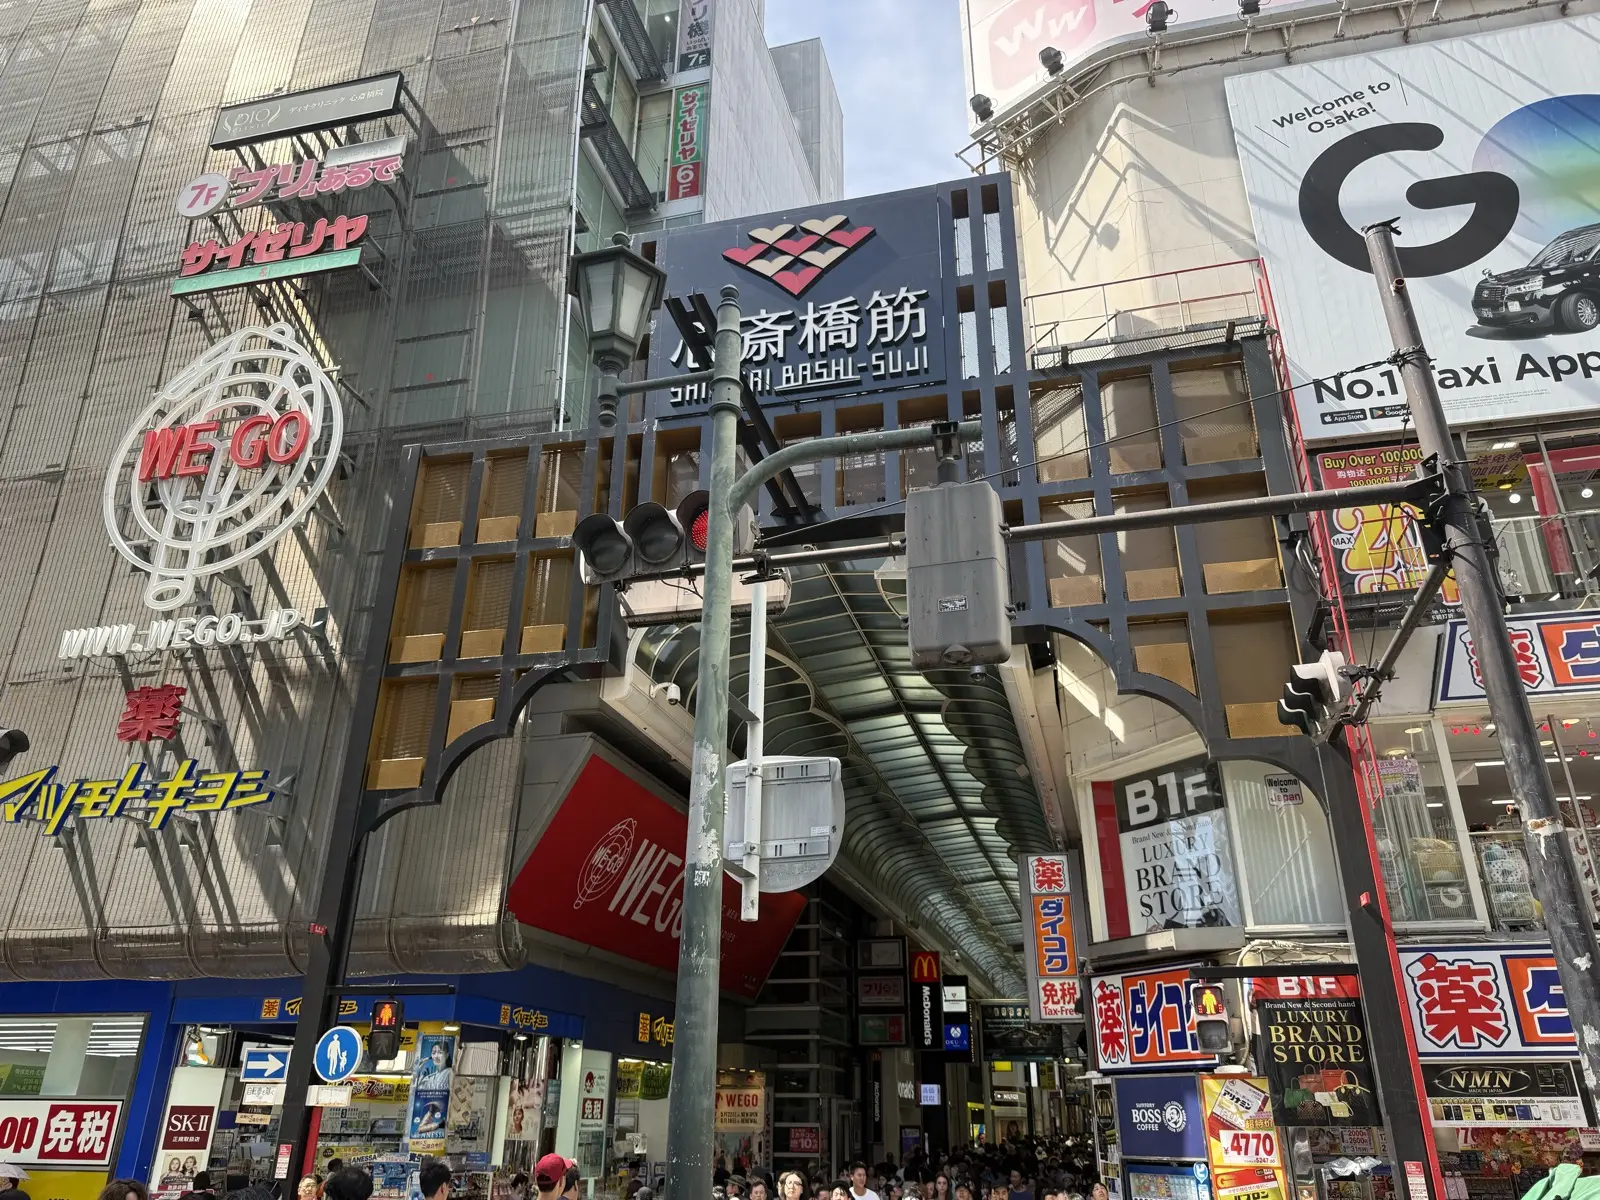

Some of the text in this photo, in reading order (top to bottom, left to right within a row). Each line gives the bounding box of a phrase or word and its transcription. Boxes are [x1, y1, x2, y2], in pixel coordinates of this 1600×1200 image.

[688, 53, 707, 66] 7F
[1272, 80, 1391, 129] Welcome to
[677, 90, 699, 162] サイゼリヤ
[1306, 101, 1377, 135] Osaka!
[676, 165, 694, 199] 6F
[187, 183, 219, 208] 7F
[179, 214, 369, 277] サイゼリヤ
[1313, 368, 1399, 404] No.1
[1515, 349, 1600, 383] App
[1323, 457, 1346, 470] Buy
[1349, 454, 1376, 467] Over
[1331, 536, 1353, 547] MAX
[58, 608, 301, 661] WWW.WEGO.JP
[116, 684, 188, 743] 薬
[1266, 776, 1298, 788] Welcome
[0, 759, 276, 836] マツモトキヨシ
[1124, 771, 1209, 826] B1F
[1269, 792, 1301, 803] Japan
[1131, 833, 1151, 845] Brand
[1151, 830, 1164, 840] New
[1141, 832, 1209, 863] LUXURY
[1034, 856, 1066, 892] 薬
[1135, 853, 1222, 892] BRAND
[1139, 880, 1224, 918] STORE
[1039, 897, 1070, 974] ダイコク
[1041, 981, 1078, 1006] 免税
[1276, 976, 1338, 996] B1F
[263, 999, 279, 1017] 薬
[1265, 1001, 1286, 1009] Brand
[1338, 1000, 1356, 1008] hand
[1410, 956, 1508, 1046] 薬
[921, 985, 933, 1046] McDonald's
[1095, 980, 1128, 1061] 薬
[1276, 1010, 1349, 1024] LUXURY
[1268, 1024, 1362, 1044] BRAND
[1273, 1045, 1365, 1063] STORE
[1447, 1070, 1513, 1088] NMN
[726, 1094, 758, 1107] WEGO
[1222, 1089, 1252, 1110] アリナミン
[169, 1113, 209, 1132] SK-II
[1131, 1109, 1162, 1123] BOSS
[1136, 1123, 1159, 1131] COFFEE
[44, 1109, 111, 1154] 免税
[1223, 1133, 1275, 1157] ¥4770
